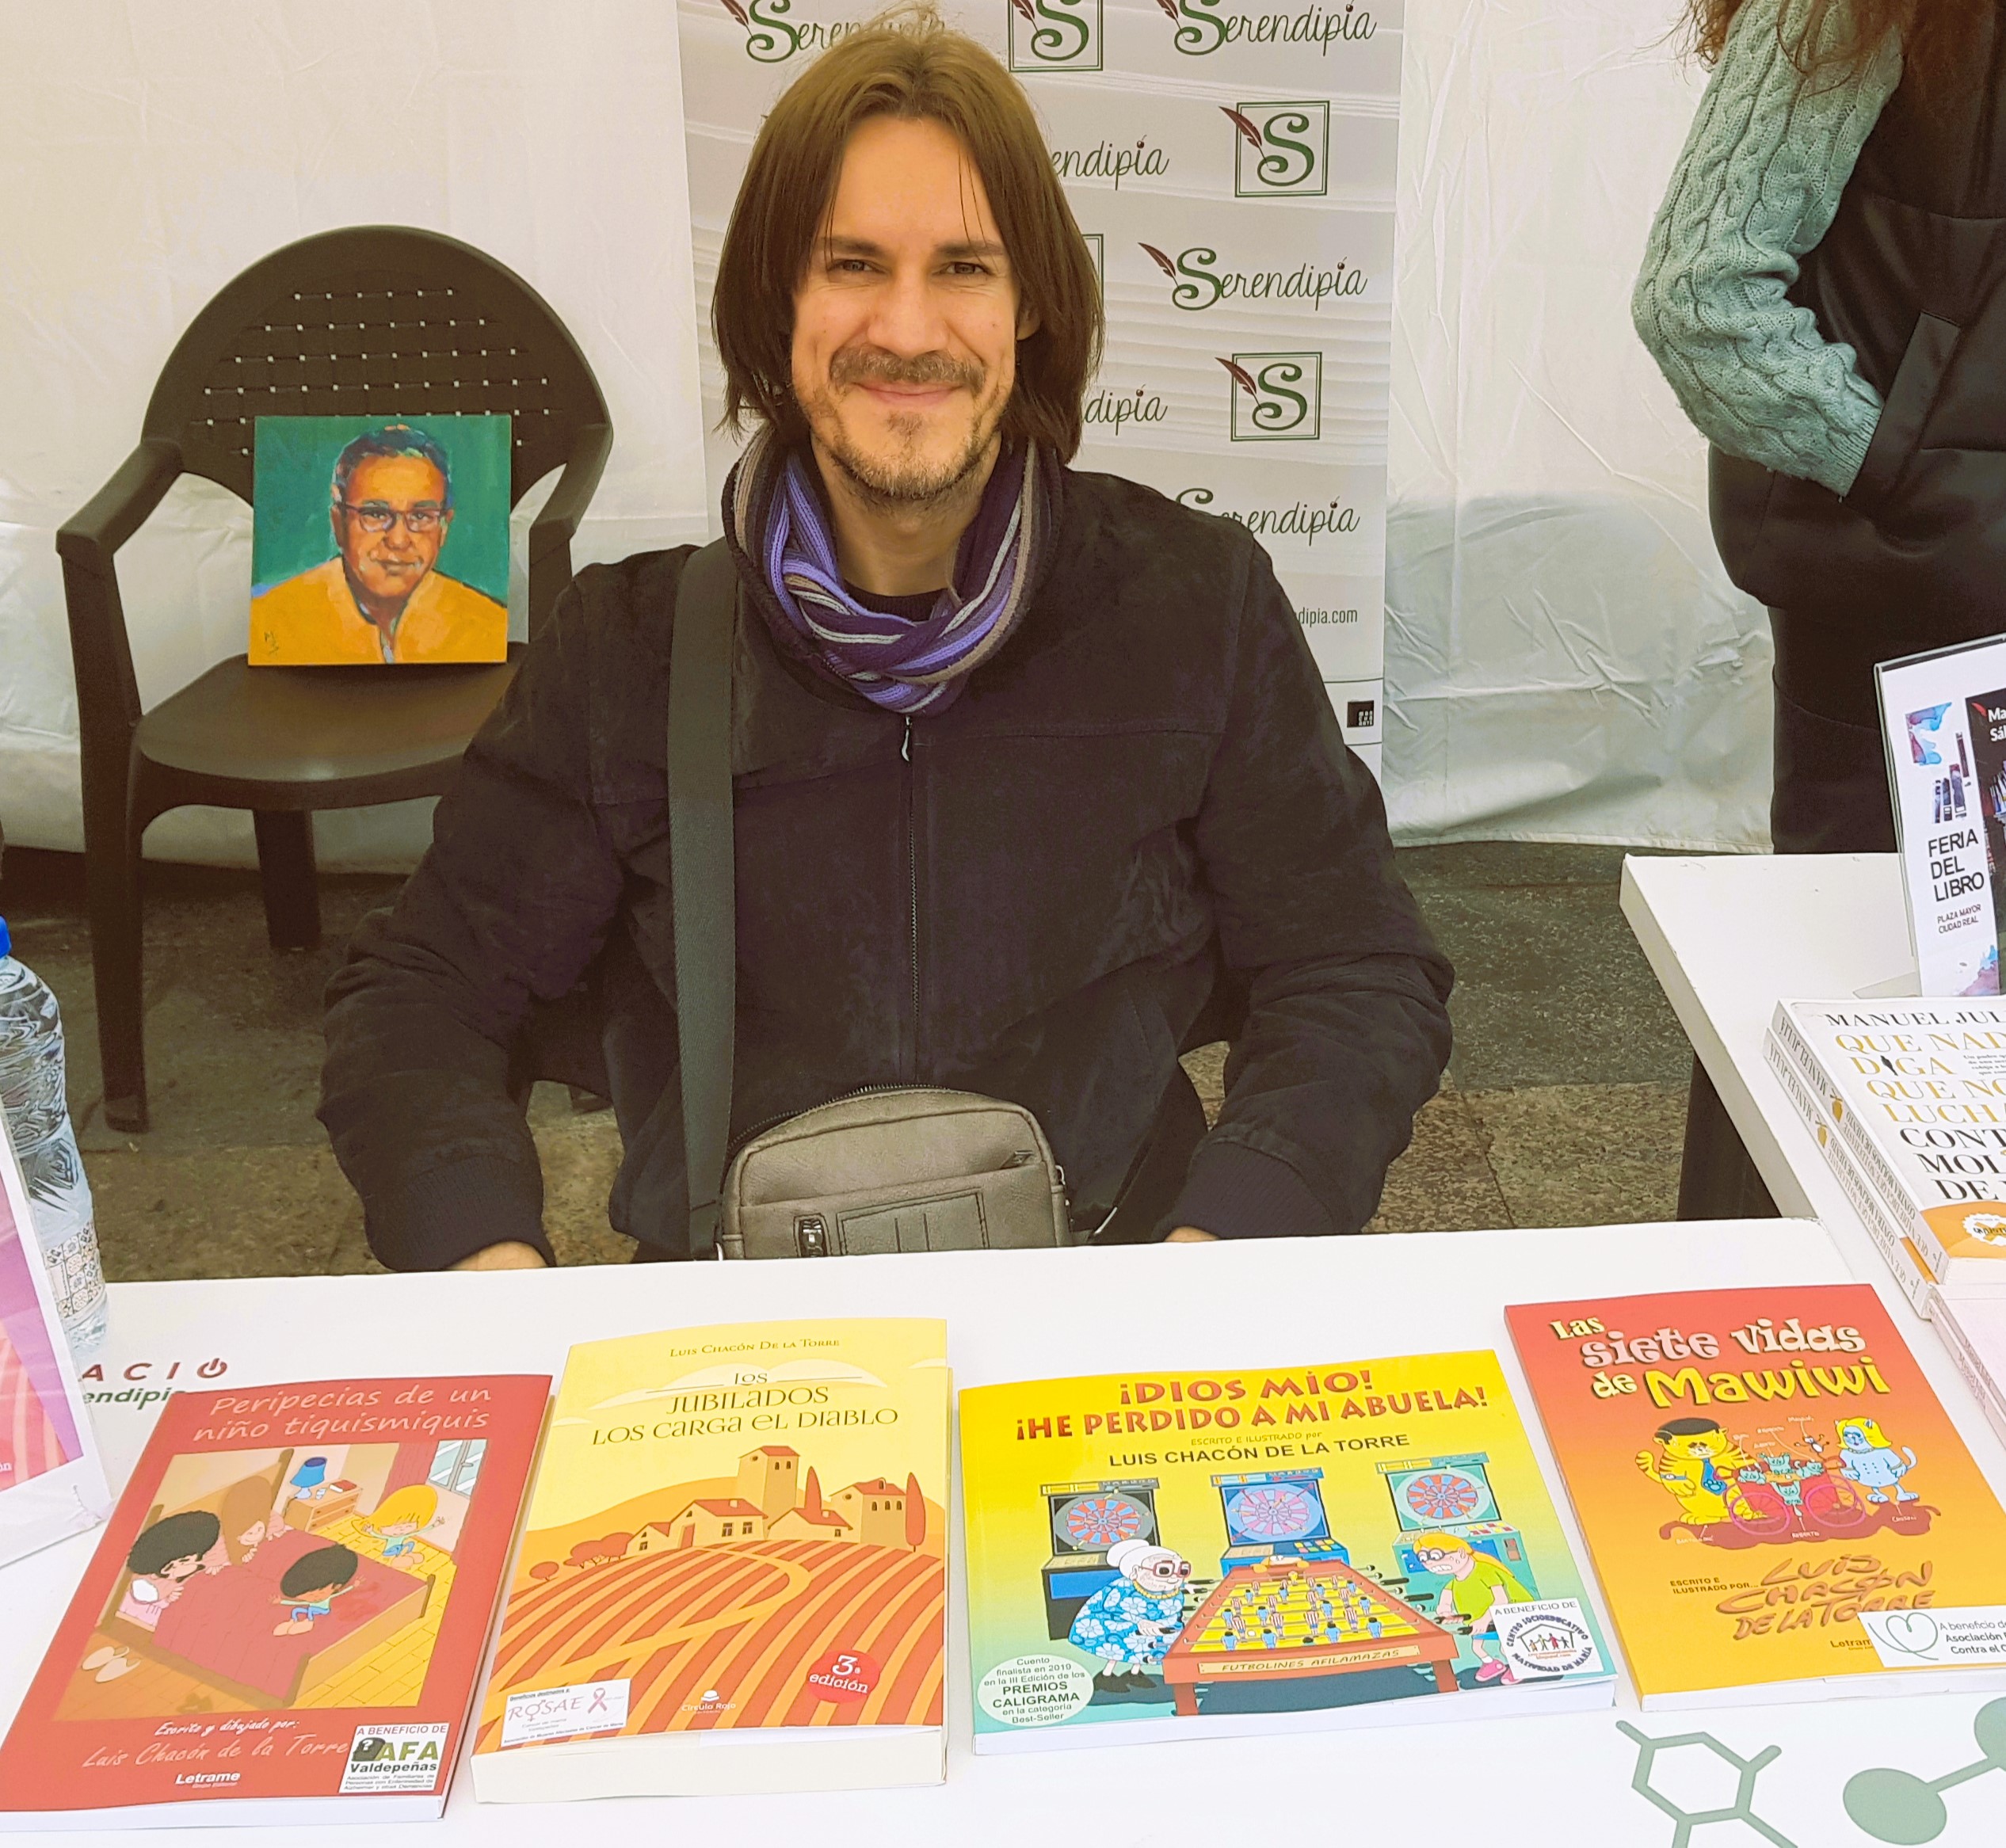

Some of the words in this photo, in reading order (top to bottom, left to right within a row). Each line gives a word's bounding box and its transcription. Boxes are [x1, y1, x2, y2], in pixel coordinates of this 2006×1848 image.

[1052, 135, 1169, 191] endipia
[1084, 384, 1168, 436] dipia
[1299, 606, 1357, 627] dipia.com
[1928, 829, 1979, 857] FERIA
[1931, 855, 1965, 879] DEL
[1934, 872, 1984, 901] LIBRO
[1937, 911, 1958, 924] PLAZA
[1959, 904, 1981, 916] MAYOR
[1939, 920, 1962, 934] CIUDAD
[1962, 916, 1979, 925] REAL
[1825, 1012, 1950, 1027] MANUEL
[1955, 1011, 2006, 1024] JUL
[1836, 1034, 1923, 1055] QUE
[1925, 1032, 2006, 1051] NAD
[1867, 1080, 1957, 1102] QUE
[1880, 1103, 2006, 1123] LUCH
[1900, 1128, 2006, 1149] CONT
[1913, 1153, 2006, 1175] MOL
[1932, 1179, 1999, 1200] DE
[1550, 1316, 1606, 1339] Las
[1580, 1328, 1719, 1368] siete
[1119, 1379, 1246, 1404] ¡DIOS
[1260, 1370, 1373, 1399] MÍO!
[1592, 1371, 1638, 1398] de
[1645, 1356, 1891, 1408] Mawiwi
[82, 1388, 186, 1410] endipi
[210, 1385, 382, 1416] Peripecias
[395, 1385, 433, 1404] de
[449, 1388, 490, 1403] un
[1016, 1415, 1073, 1440] ¡HE
[1084, 1407, 1241, 1435] PERDIDO
[1251, 1404, 1276, 1427] A
[1286, 1400, 1329, 1424] MI
[1341, 1386, 1488, 1419] ABUELA!
[193, 1419, 269, 1442] niño
[284, 1408, 490, 1440] tiquismiquis
[593, 1424, 644, 1446] LOS
[1191, 1437, 1233, 1446] ESCRITO
[1245, 1432, 1302, 1443] ILUSTRADO
[1306, 1431, 1322, 1440] por
[1109, 1452, 1157, 1466] LUIS
[1165, 1445, 1258, 1464] CHACÓN
[1265, 1446, 1295, 1458] DE
[1301, 1441, 1329, 1455] LA
[1333, 1434, 1410, 1453] TORRE
[1761, 1554, 1881, 1586] LUIS
[1672, 1583, 1728, 1594] ILUSTRADO
[1504, 1603, 1559, 1614] BENEFICIO
[1506, 1622, 1523, 1647] CENTRO
[1733, 1613, 1777, 1640] DE
[1776, 1609, 1813, 1633] LA
[1947, 1621, 1996, 1630] beneficio
[1946, 1632, 2003, 1642] Asociación
[1222, 1660, 1303, 1671] FUTBOLINES
[1310, 1649, 1399, 1665] AFILAMAZAS
[1951, 1645, 1987, 1654] Contra
[997, 1667, 1031, 1676] finalista
[1021, 1674, 1054, 1683] Edición
[809, 1674, 869, 1694] edición
[1003, 1681, 1068, 1695] PREMIOS
[993, 1693, 1080, 1708] CALIGRAMA
[154, 1721, 201, 1736] Escrito
[200, 1724, 214, 1736] y
[219, 1718, 269, 1735] dibujado
[269, 1720, 299, 1732] por:
[1013, 1713, 1064, 1724] Best-Seller
[368, 1726, 429, 1735] BENEFICIO
[82, 1747, 128, 1767] Luis
[135, 1743, 207, 1765] Chacón
[218, 1739, 242, 1758] de
[251, 1736, 273, 1756] la
[285, 1734, 349, 1756] Torre
[373, 1741, 438, 1761] AFA
[350, 1762, 437, 1774] Valdepeñas
[175, 1773, 240, 1785] Letrame
